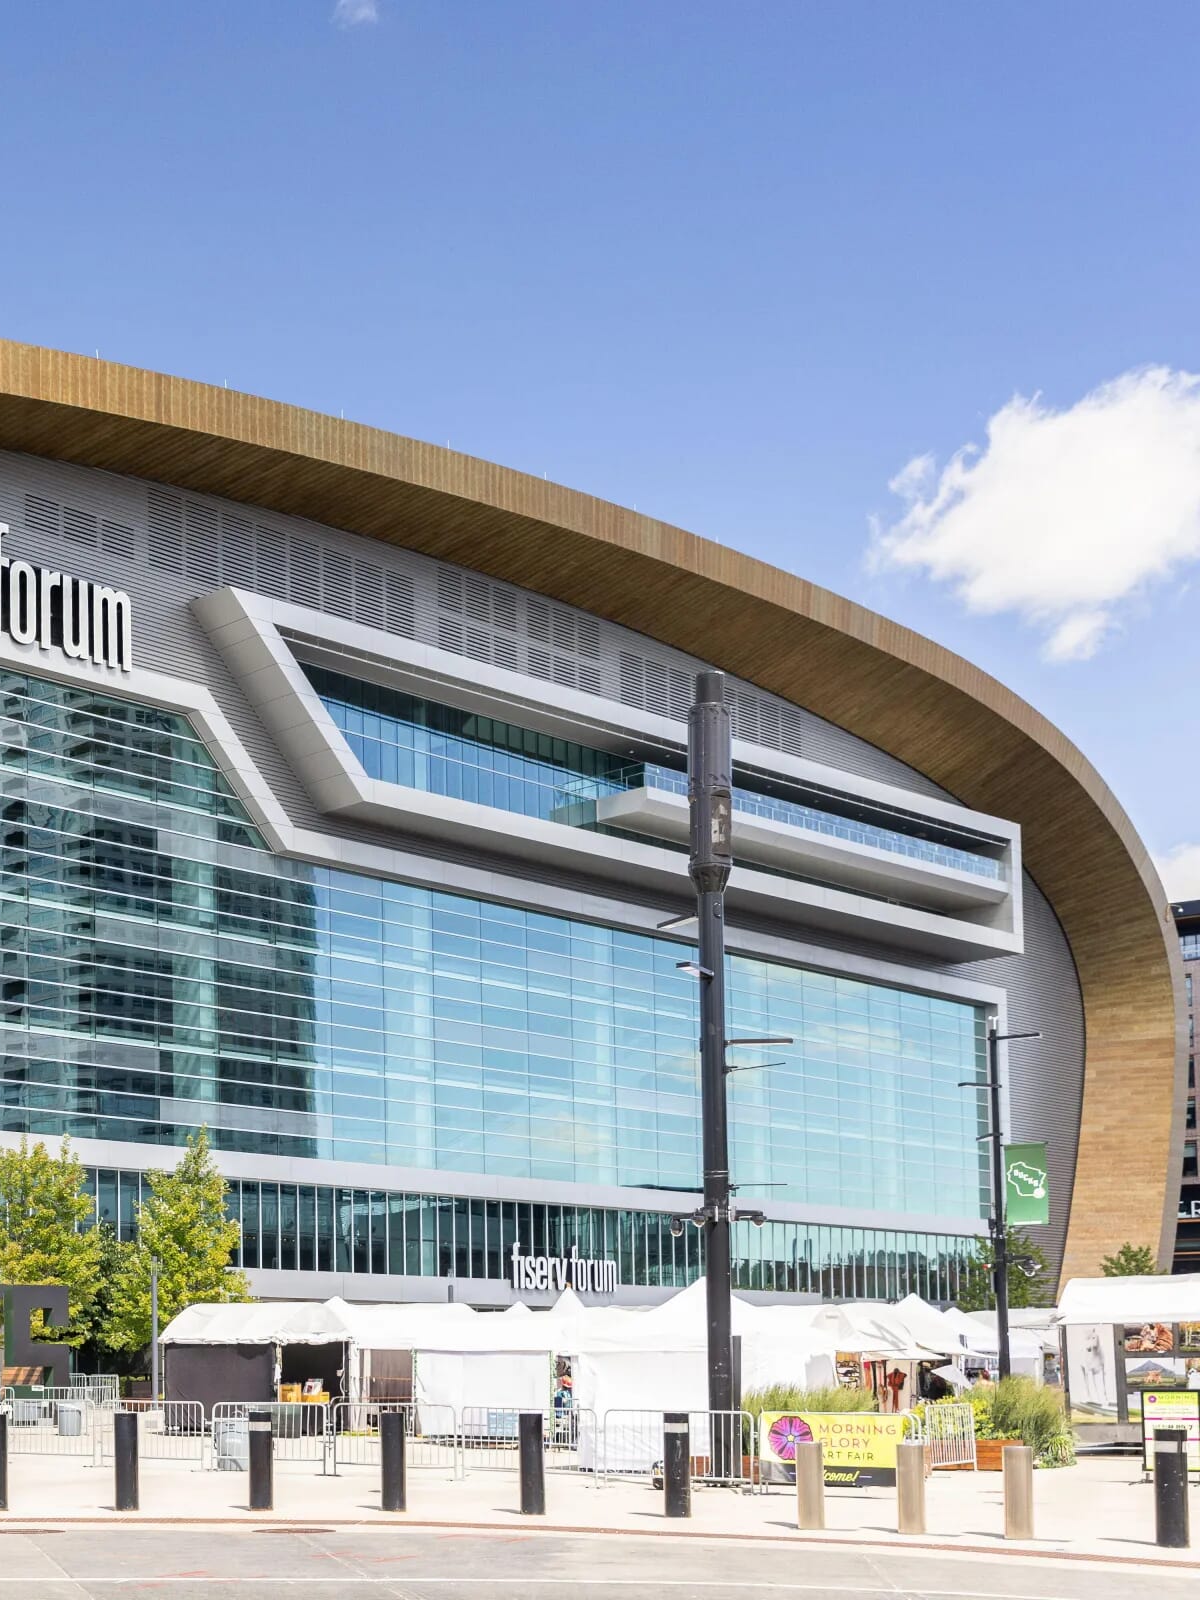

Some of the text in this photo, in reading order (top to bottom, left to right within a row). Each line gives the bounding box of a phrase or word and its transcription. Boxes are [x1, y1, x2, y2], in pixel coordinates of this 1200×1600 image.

[819, 1423, 897, 1435] MORNING
[819, 1437, 871, 1449] GLORY
[847, 1451, 875, 1461] FAIR
[823, 1469, 861, 1482] come!
